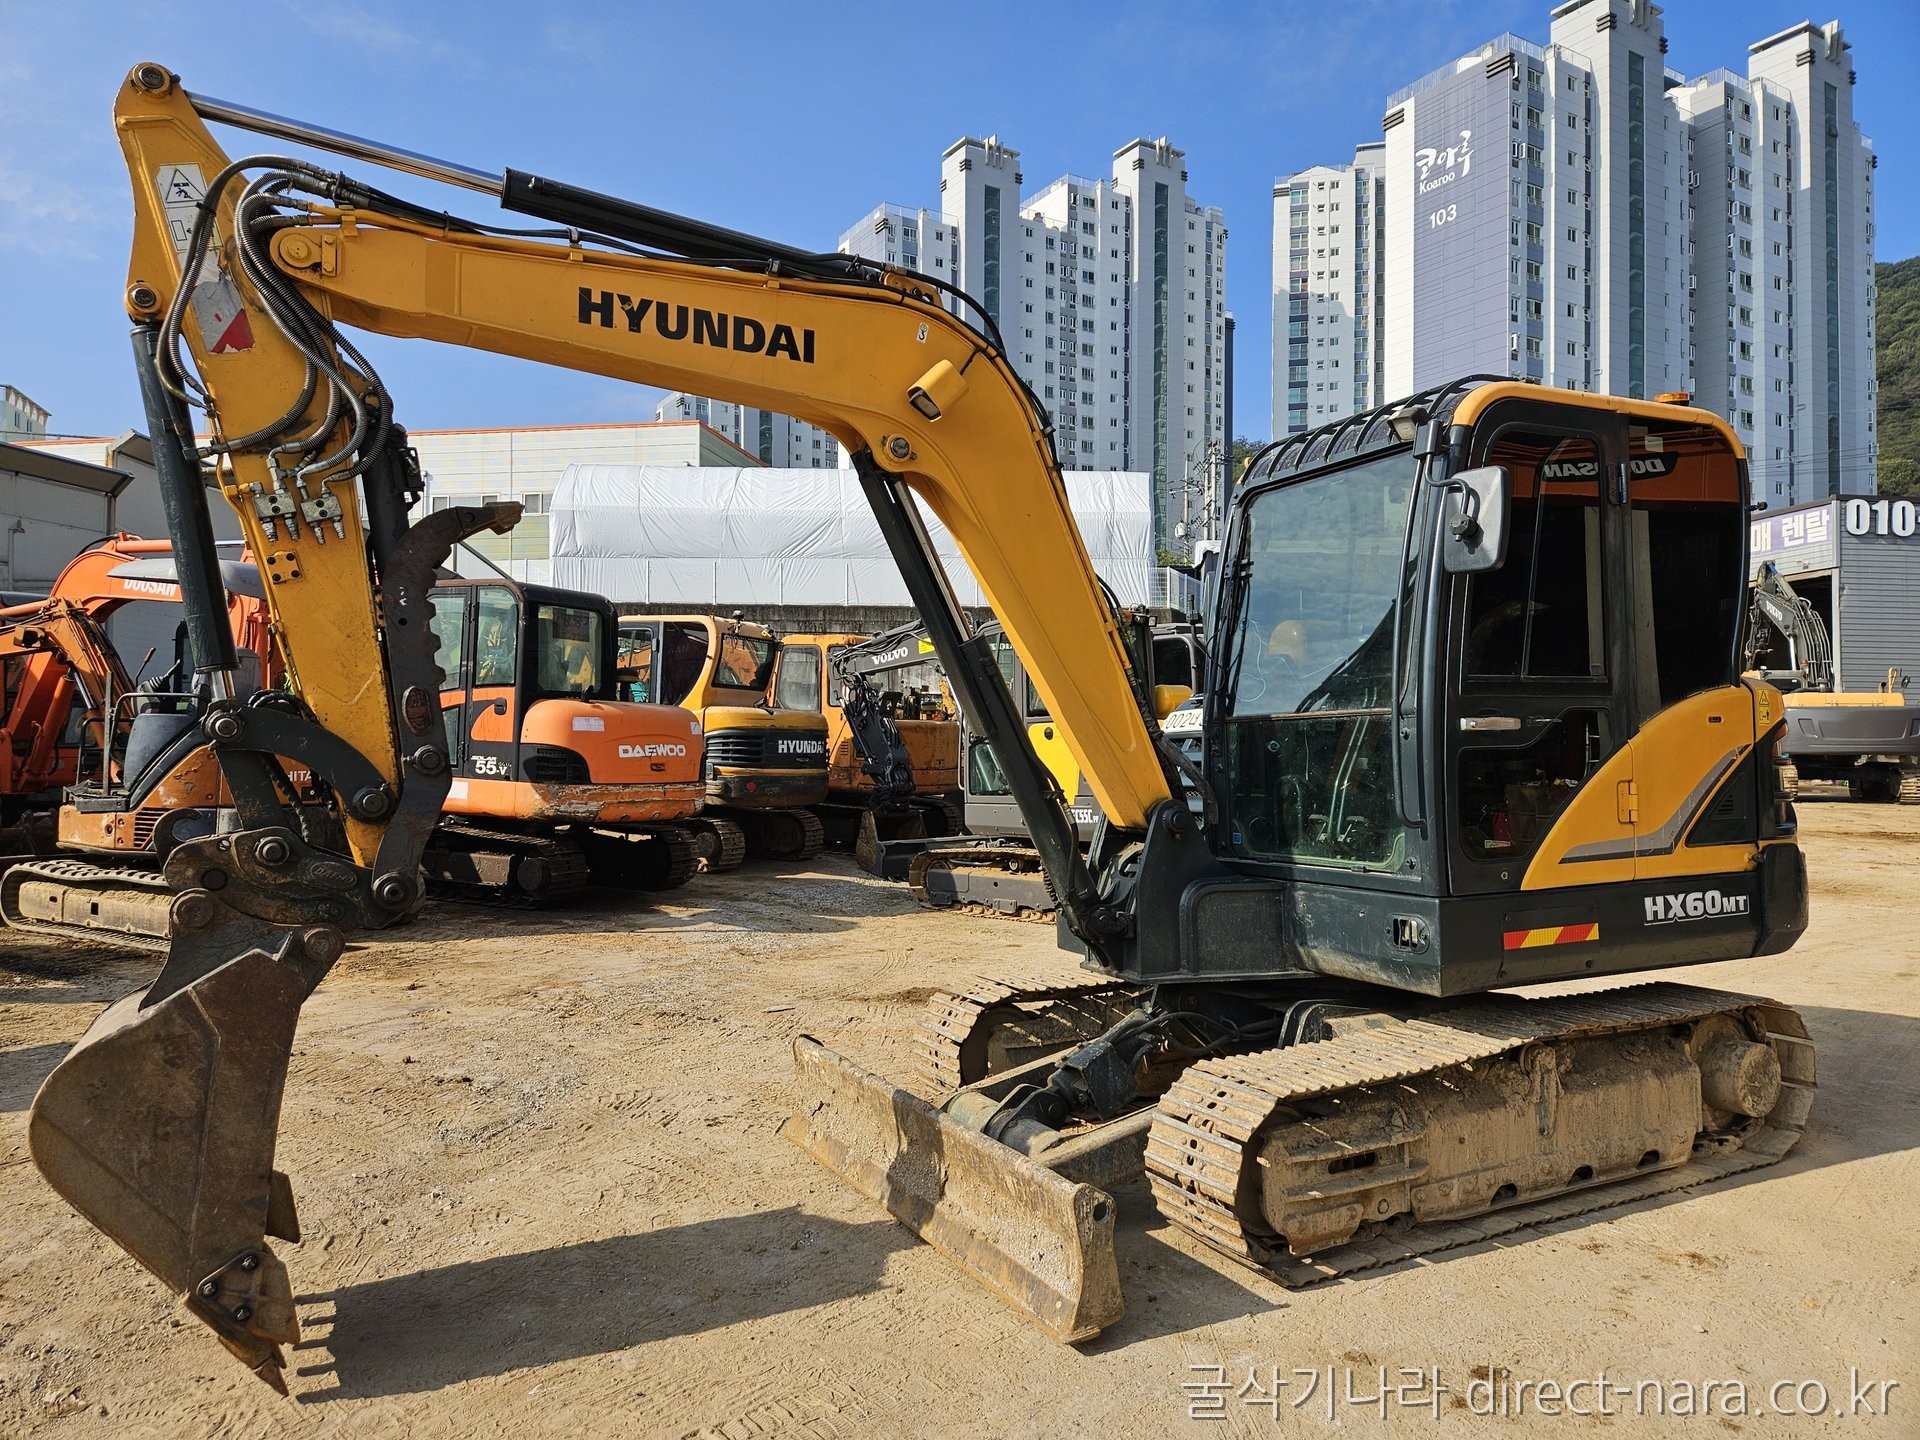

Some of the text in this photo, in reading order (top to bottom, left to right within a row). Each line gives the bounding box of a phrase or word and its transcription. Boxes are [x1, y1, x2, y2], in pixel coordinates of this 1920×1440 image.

[1419, 172, 1455, 195] Koaroo
[1430, 204, 1457, 228] 103
[579, 286, 815, 364] HYUNDAI
[1782, 508, 1829, 547] 렌탈
[1846, 499, 1920, 537] 010
[872, 647, 908, 665] VOLVO
[618, 744, 686, 758] DAEWOO
[1644, 890, 1747, 921] HX60MT
